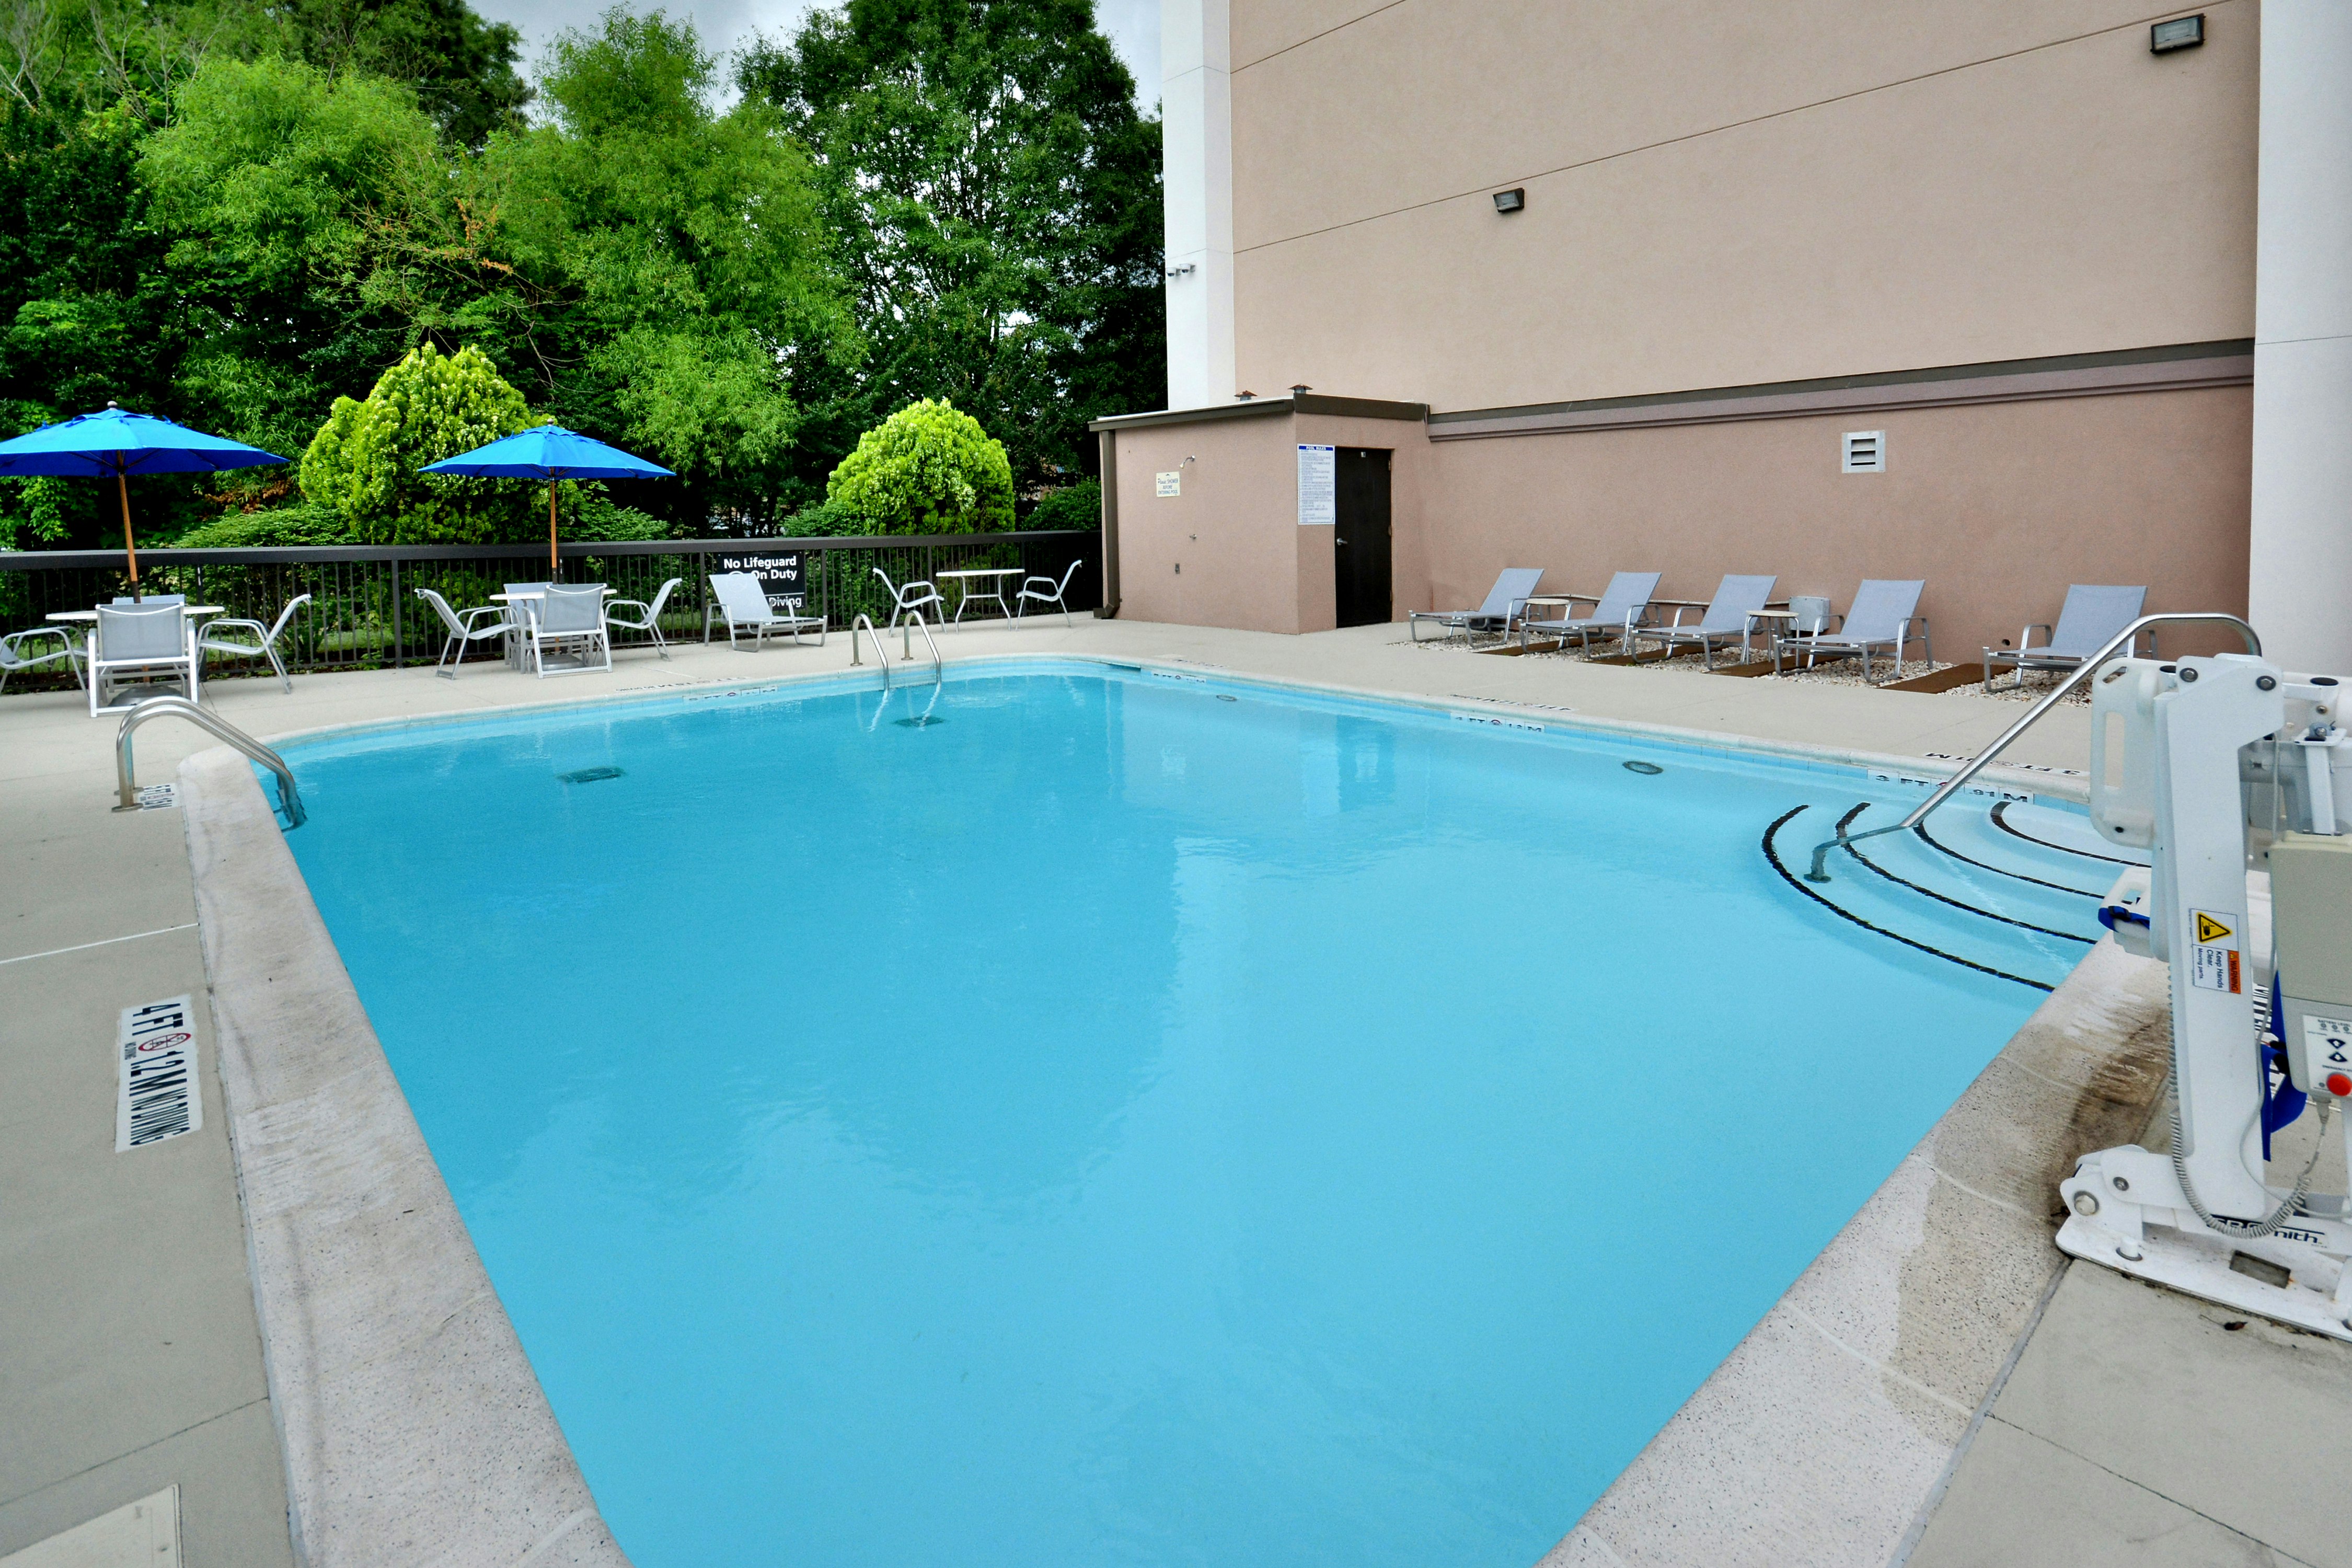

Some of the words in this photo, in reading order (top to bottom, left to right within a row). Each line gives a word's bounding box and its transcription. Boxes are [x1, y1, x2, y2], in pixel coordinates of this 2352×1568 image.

[724, 559, 740, 569] No
[744, 556, 796, 570] Lifeguard
[751, 570, 767, 580] On
[770, 569, 797, 581] Duty
[769, 596, 802, 607] Diving
[1900, 778, 1929, 786] FT
[2003, 793, 2028, 802] M
[2230, 960, 2238, 991] WARNING
[133, 1003, 180, 1017] 4
[132, 1012, 183, 1036] FT
[129, 1068, 188, 1097] M
[131, 1087, 188, 1111] NO
[130, 1102, 190, 1145] DIVING
